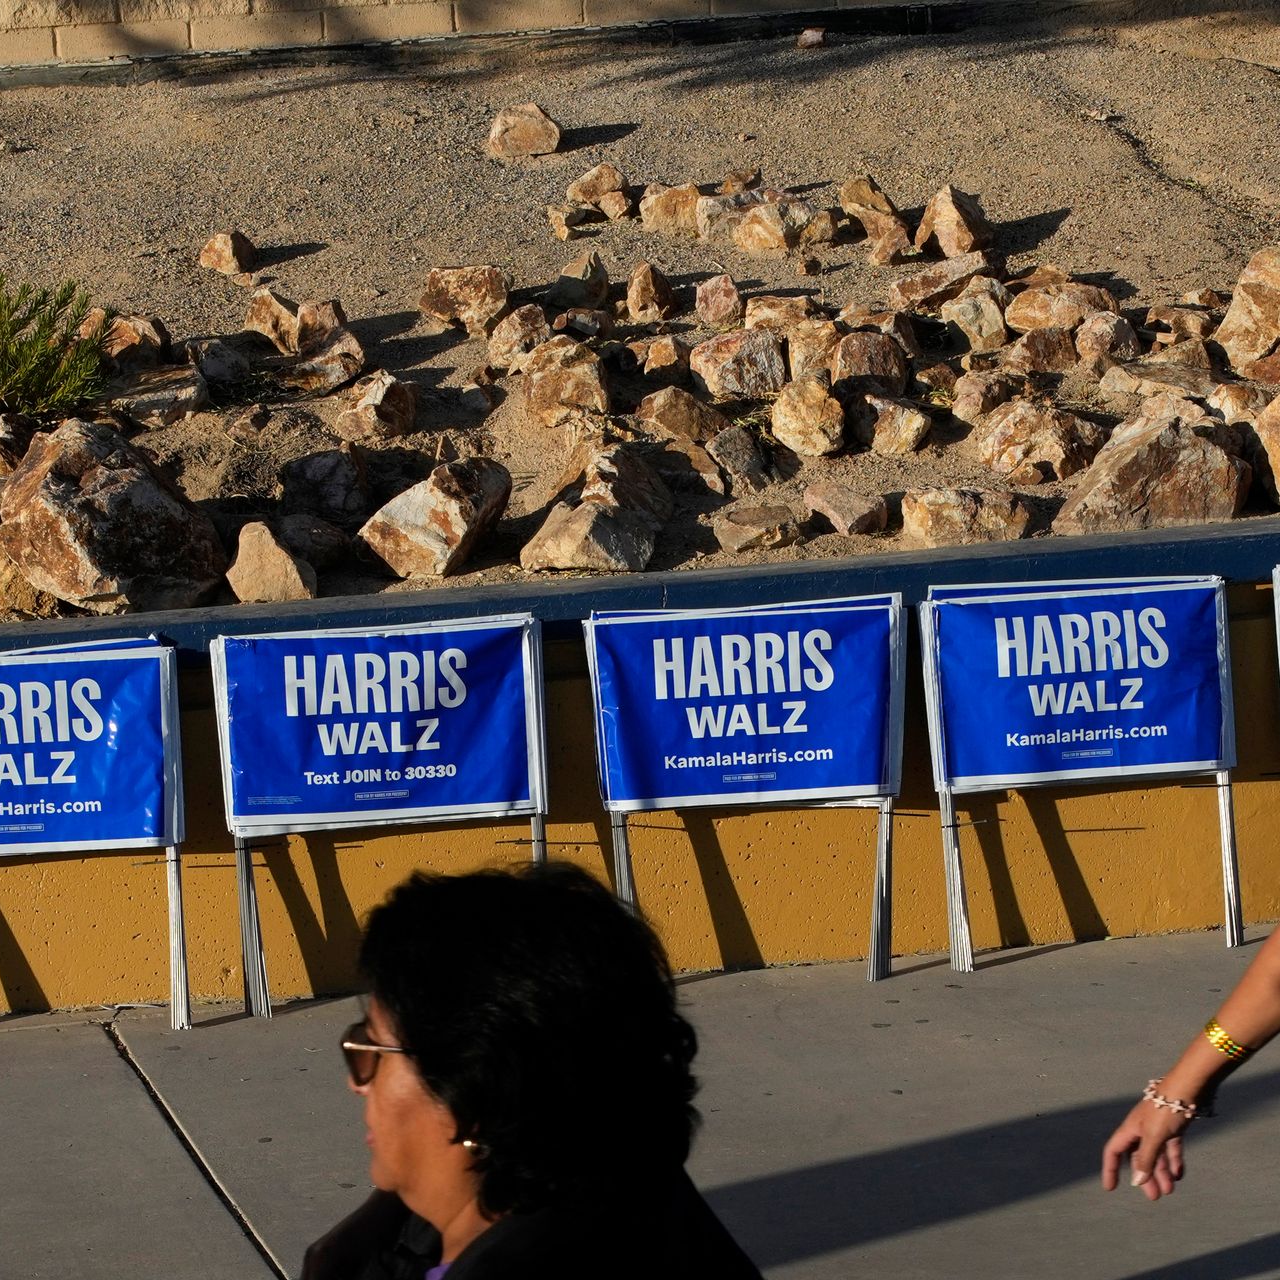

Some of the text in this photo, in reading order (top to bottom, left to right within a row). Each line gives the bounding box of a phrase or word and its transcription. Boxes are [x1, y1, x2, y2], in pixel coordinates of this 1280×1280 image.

[994, 607, 1169, 678] HARRIS
[284, 648, 466, 716] HARRIS
[653, 629, 834, 699] HARRIS
[1028, 678, 1143, 716] WALZ
[318, 718, 440, 755] WALZ
[686, 701, 807, 738] WALZ
[1007, 725, 1167, 746] KamalaHarris.com
[304, 764, 456, 785] Text JOIN to 30330
[665, 749, 833, 769] KamalaHarris.com
